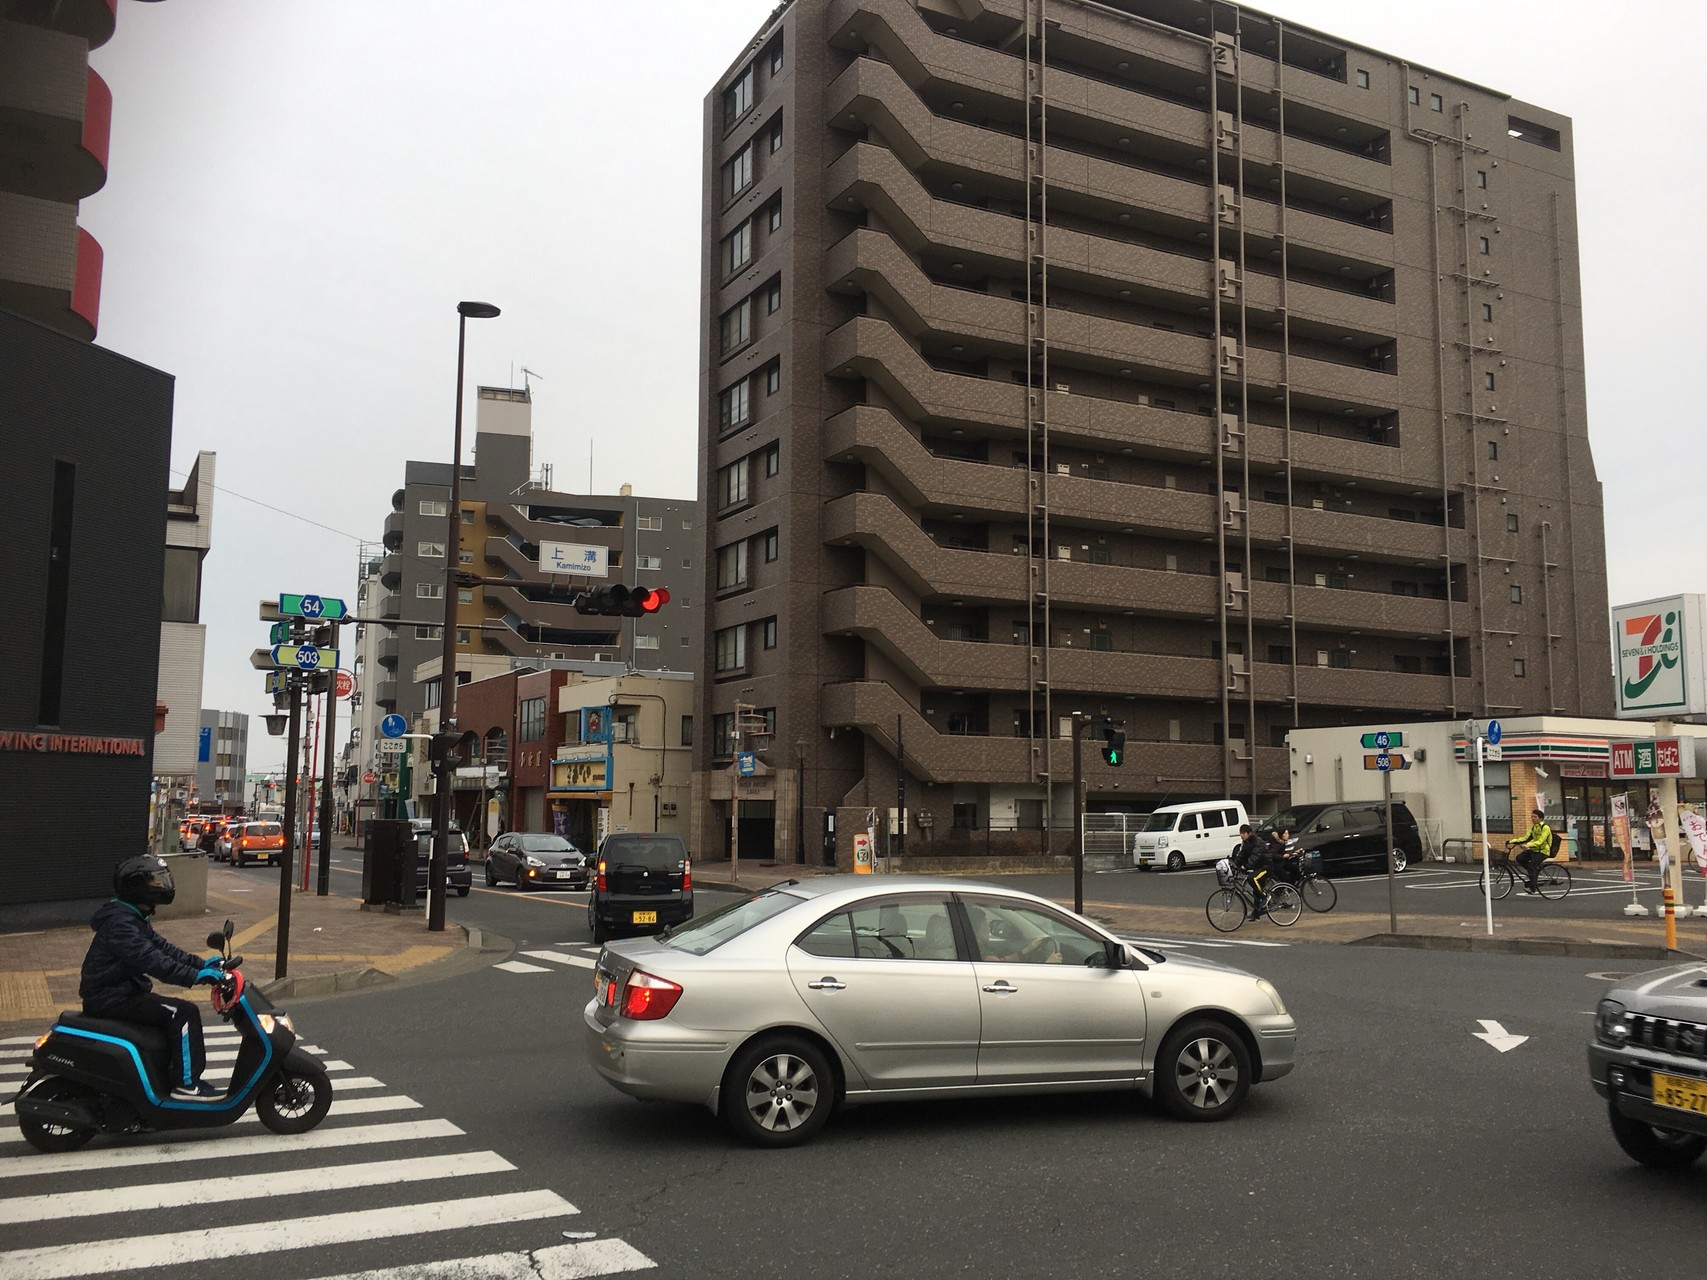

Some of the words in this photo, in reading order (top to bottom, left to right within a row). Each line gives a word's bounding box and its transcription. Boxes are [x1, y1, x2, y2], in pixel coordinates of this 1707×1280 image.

[556, 562, 591, 571] Kamimizo
[303, 599, 320, 614] 54
[1648, 642, 1679, 654] HOLDINGS
[297, 650, 318, 664] 503
[50, 735, 146, 757] INTERNATIONAL
[383, 741, 404, 750] ここから
[1376, 735, 1388, 746] 46
[1377, 757, 1390, 767] 508
[1614, 750, 1634, 769] ATM
[1638, 748, 1652, 769] 酒
[1657, 746, 1679, 768] たばこ
